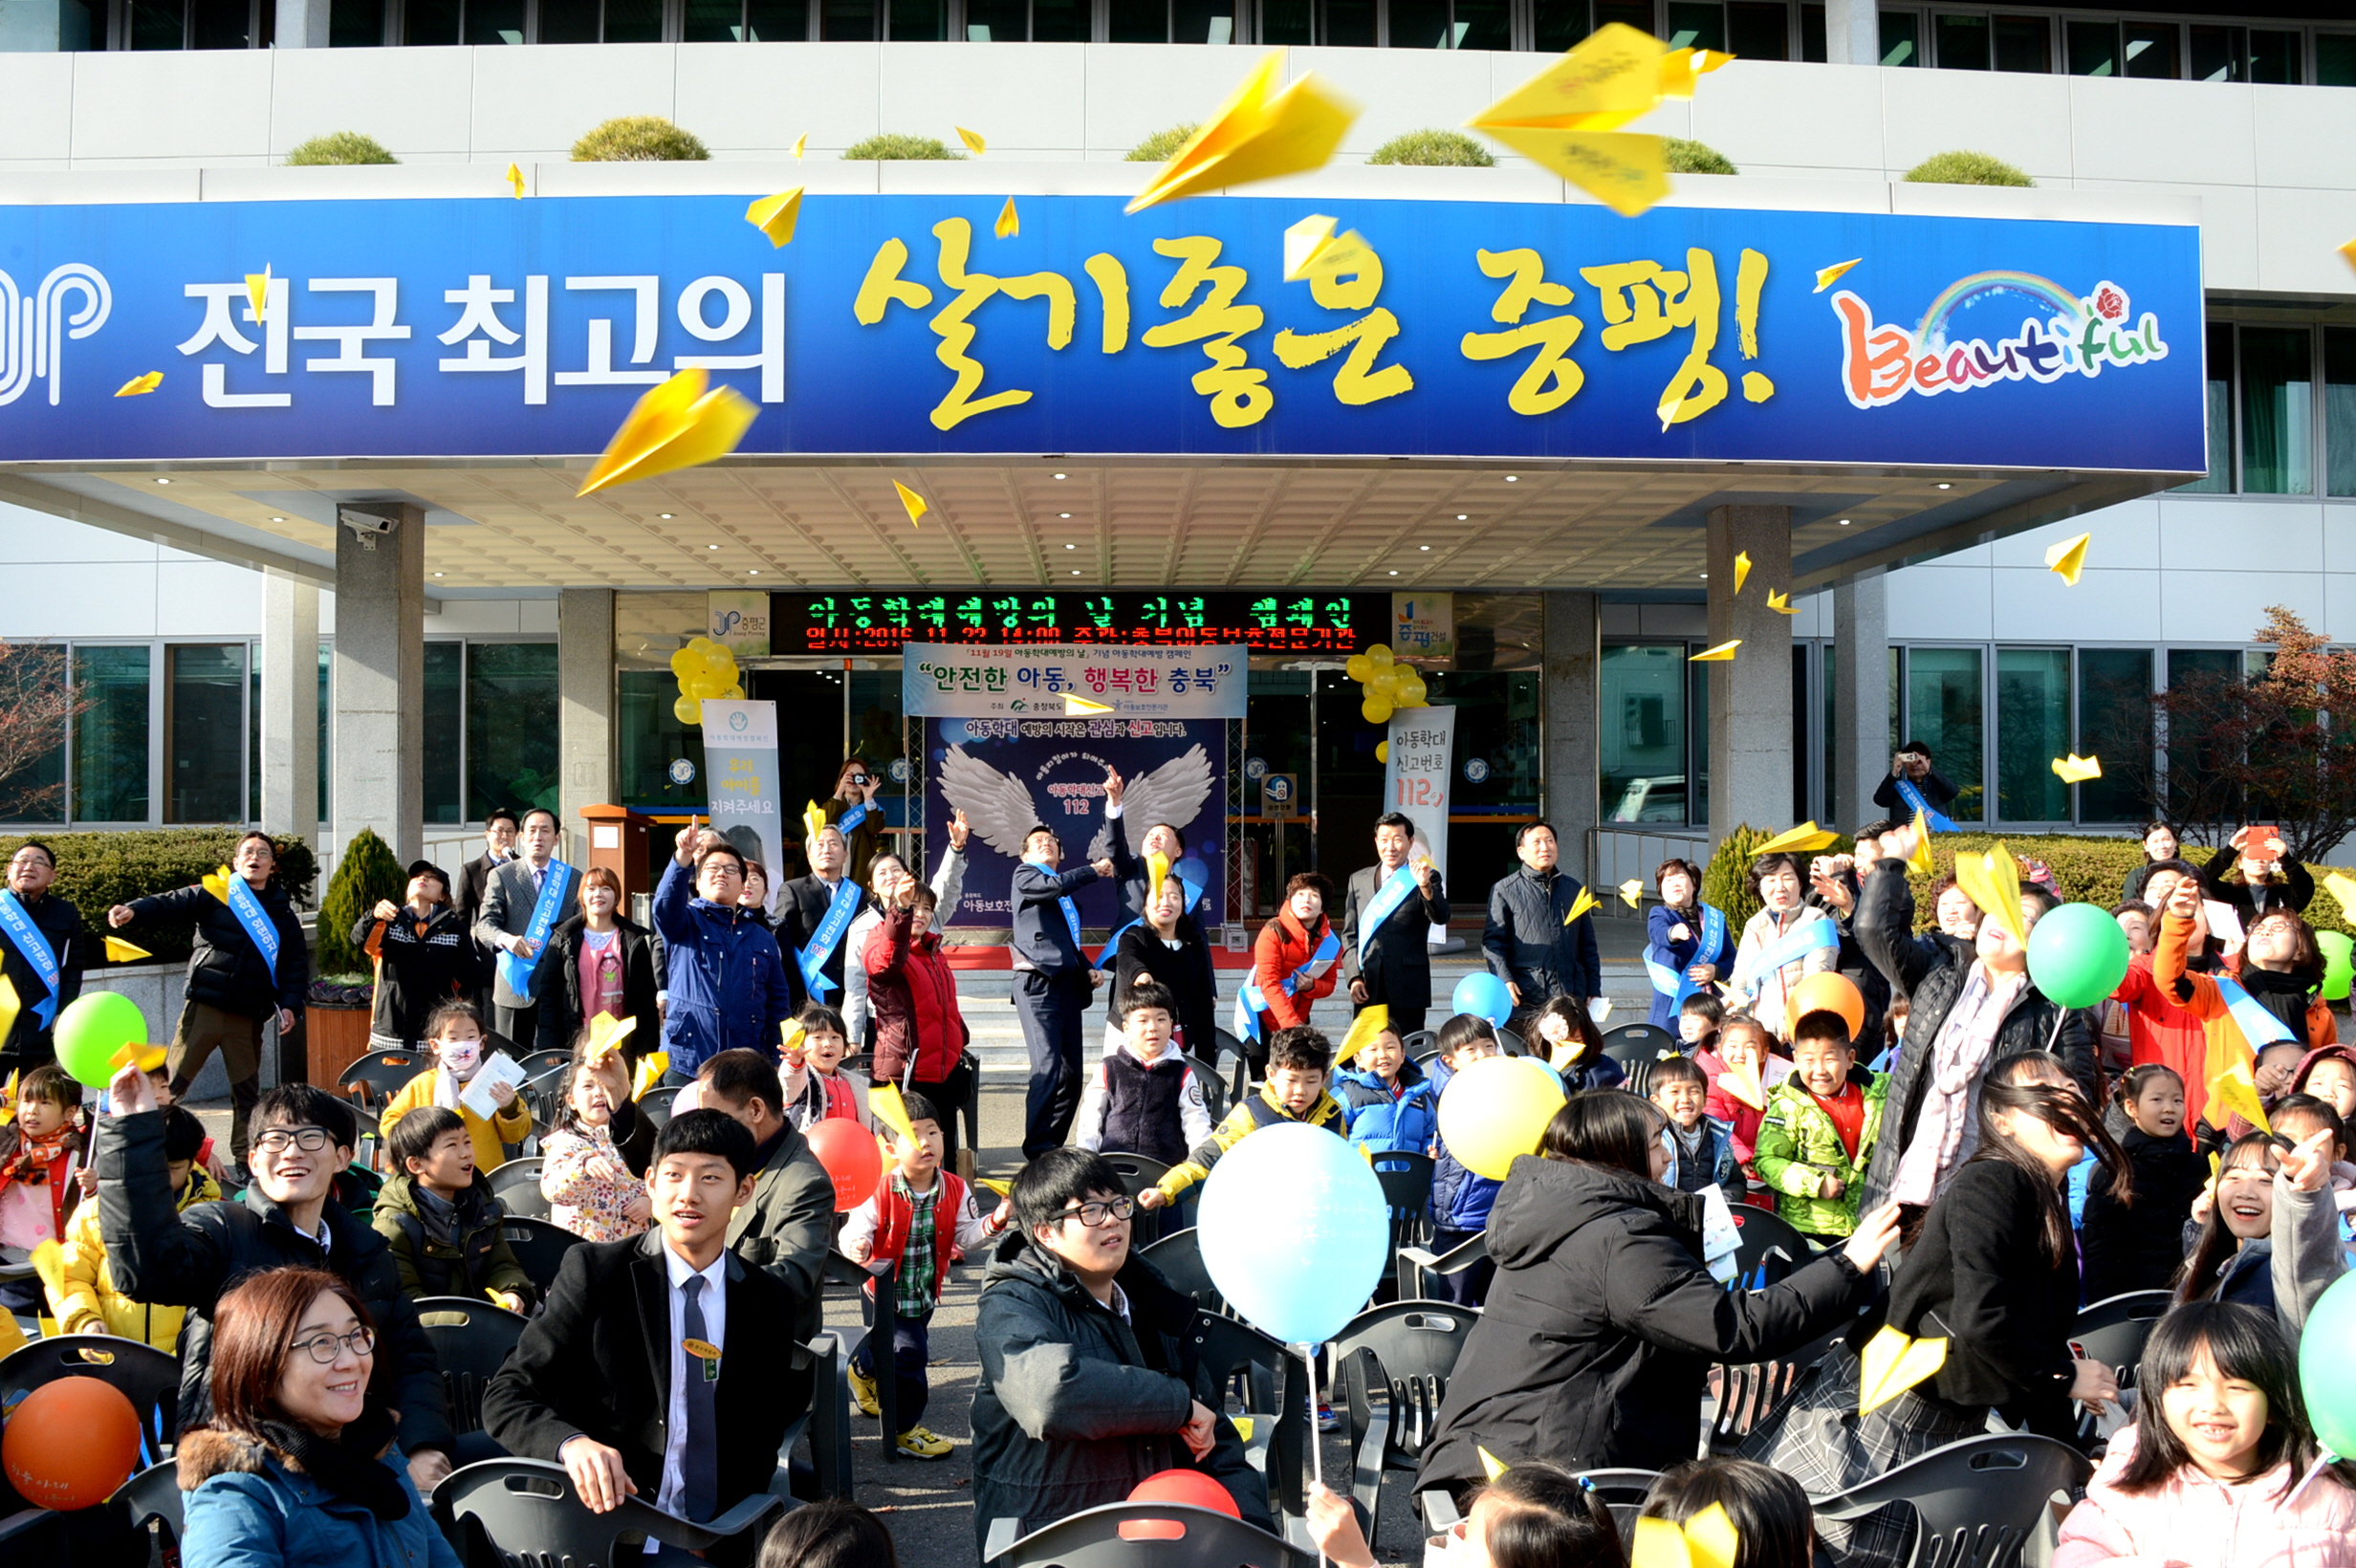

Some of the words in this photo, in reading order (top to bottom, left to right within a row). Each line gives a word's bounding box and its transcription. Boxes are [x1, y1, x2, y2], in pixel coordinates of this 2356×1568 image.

[175, 274, 411, 408] 전국
[436, 273, 785, 406] 최고의
[1460, 247, 1775, 425] 증평!
[1835, 294, 2166, 405] Beautiful
[993, 649, 1012, 658] 19일
[1014, 649, 1074, 659] 아동학대예방의
[1093, 649, 1110, 659] 기념
[1112, 649, 1164, 660] 아동학대예방
[1166, 650, 1191, 660] 캠페인
[1016, 666, 1076, 693] 아동,
[1083, 666, 1159, 693] 행복한
[1033, 703, 1063, 711] 충청북도
[965, 718, 1019, 738] 아동학대
[1019, 722, 1053, 737] 예방의
[1054, 722, 1087, 738] 시작은
[1087, 719, 1126, 738] 관심과
[1126, 720, 1188, 738] 신고입니다.
[1396, 730, 1447, 749] 아동학대
[728, 757, 753, 773] 우리
[1396, 754, 1444, 773] 신고번호
[721, 775, 760, 796] 아이를
[1047, 783, 1106, 798] 아동학대신고
[1397, 778, 1431, 807] 112
[711, 799, 774, 815] 지켜주세요
[1063, 798, 1090, 815] 112
[549, 863, 566, 899] 아동학대
[229, 884, 258, 919] 아동학대
[963, 900, 1014, 913] 아동보호전
[534, 899, 555, 938] 신고전화
[819, 908, 846, 945] 신고전화
[22, 932, 55, 972] 신고전화
[810, 943, 827, 958] 112
